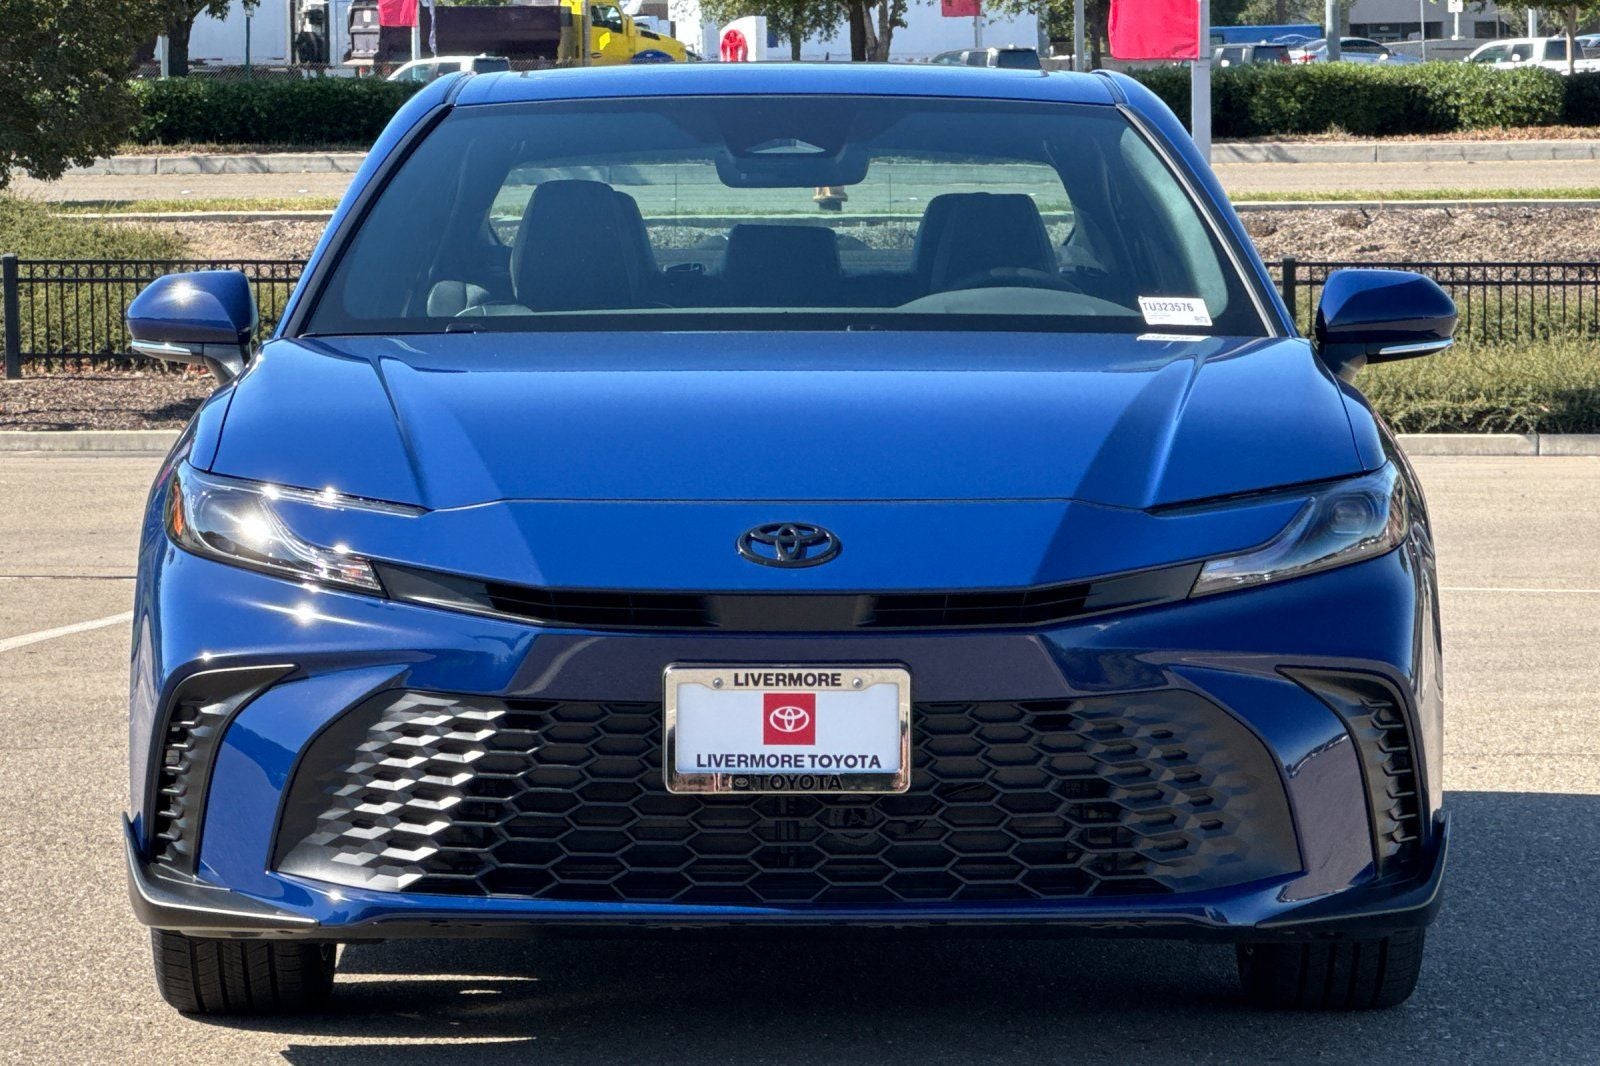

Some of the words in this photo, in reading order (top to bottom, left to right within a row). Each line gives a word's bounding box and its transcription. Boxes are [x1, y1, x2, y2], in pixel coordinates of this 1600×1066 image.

[1143, 302, 1194, 312] TU323576
[734, 672, 842, 687] LIVERMORE
[696, 754, 805, 768] LIVERMORE
[808, 754, 882, 769] TOYOTA
[756, 774, 843, 790] TOYOTA
